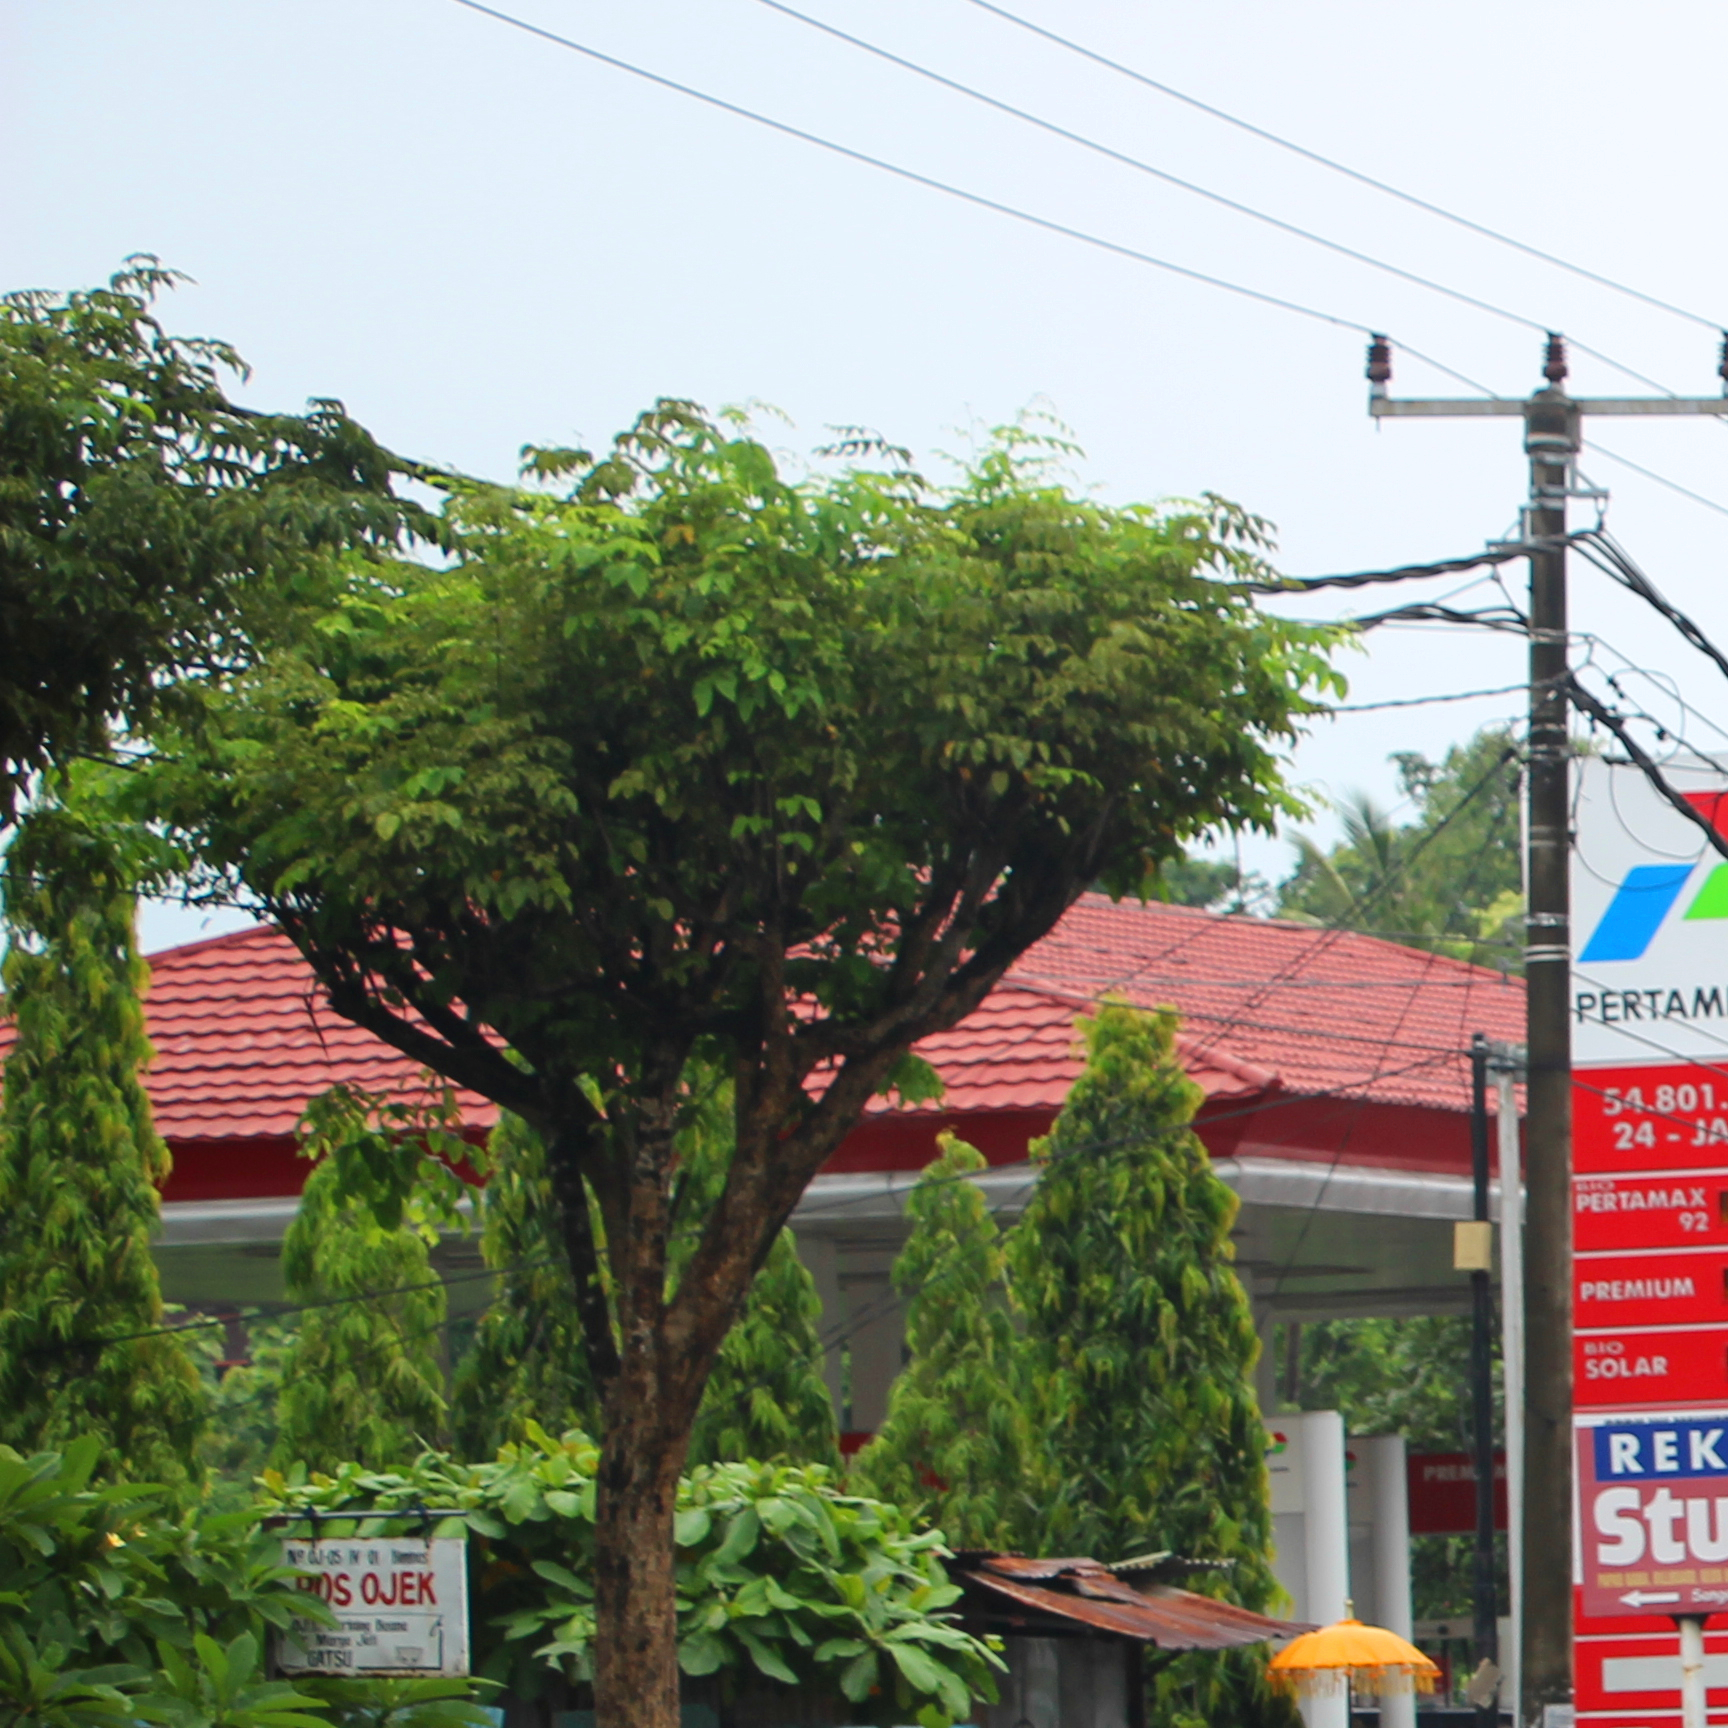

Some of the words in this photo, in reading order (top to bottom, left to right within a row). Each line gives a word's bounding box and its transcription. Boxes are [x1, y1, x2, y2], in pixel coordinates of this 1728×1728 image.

[1613, 1121, 1655, 1150] 24
[1576, 1188, 1706, 1212] PERTAMAX
[1678, 1212, 1709, 1232] 92
[1580, 1277, 1695, 1301] PREMIUM
[1585, 1356, 1668, 1379] SOLAR
[360, 1571, 437, 1606] OJEK
